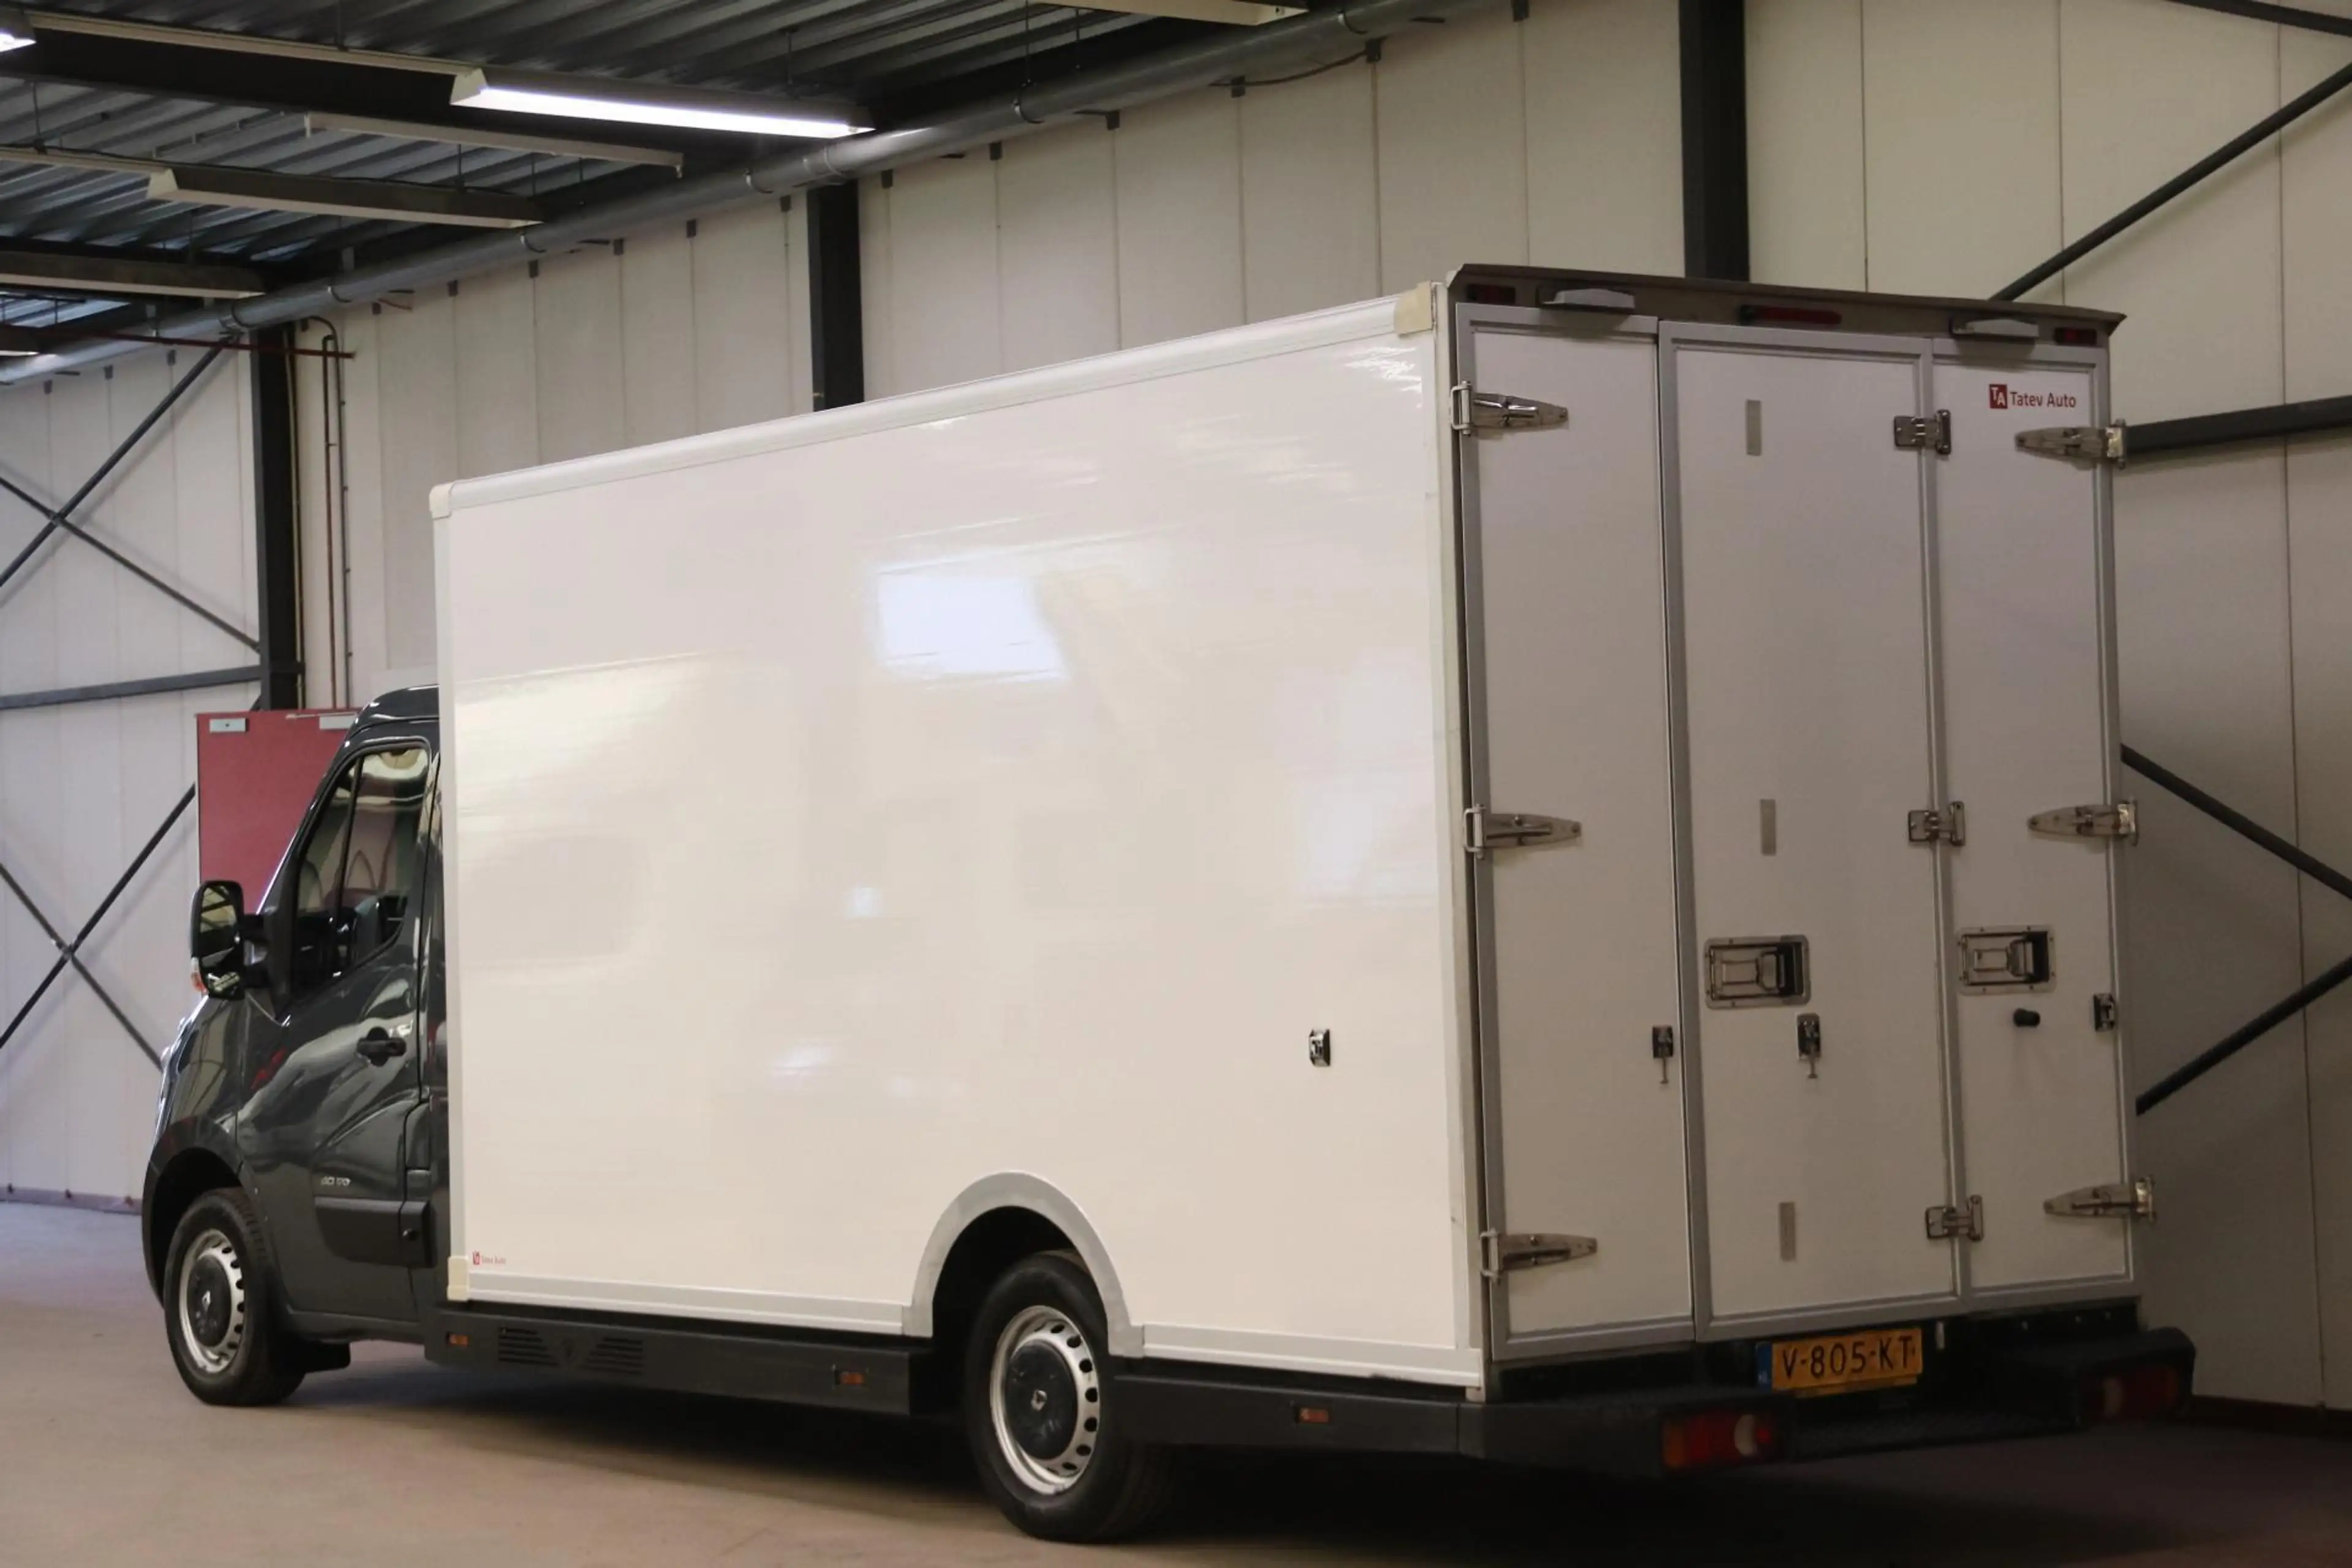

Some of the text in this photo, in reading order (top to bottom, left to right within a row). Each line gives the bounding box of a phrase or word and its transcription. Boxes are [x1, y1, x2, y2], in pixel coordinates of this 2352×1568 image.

[1990, 386, 2076, 408] TA Tatev Auto
[1782, 1335, 1913, 1379] V-805-KT
